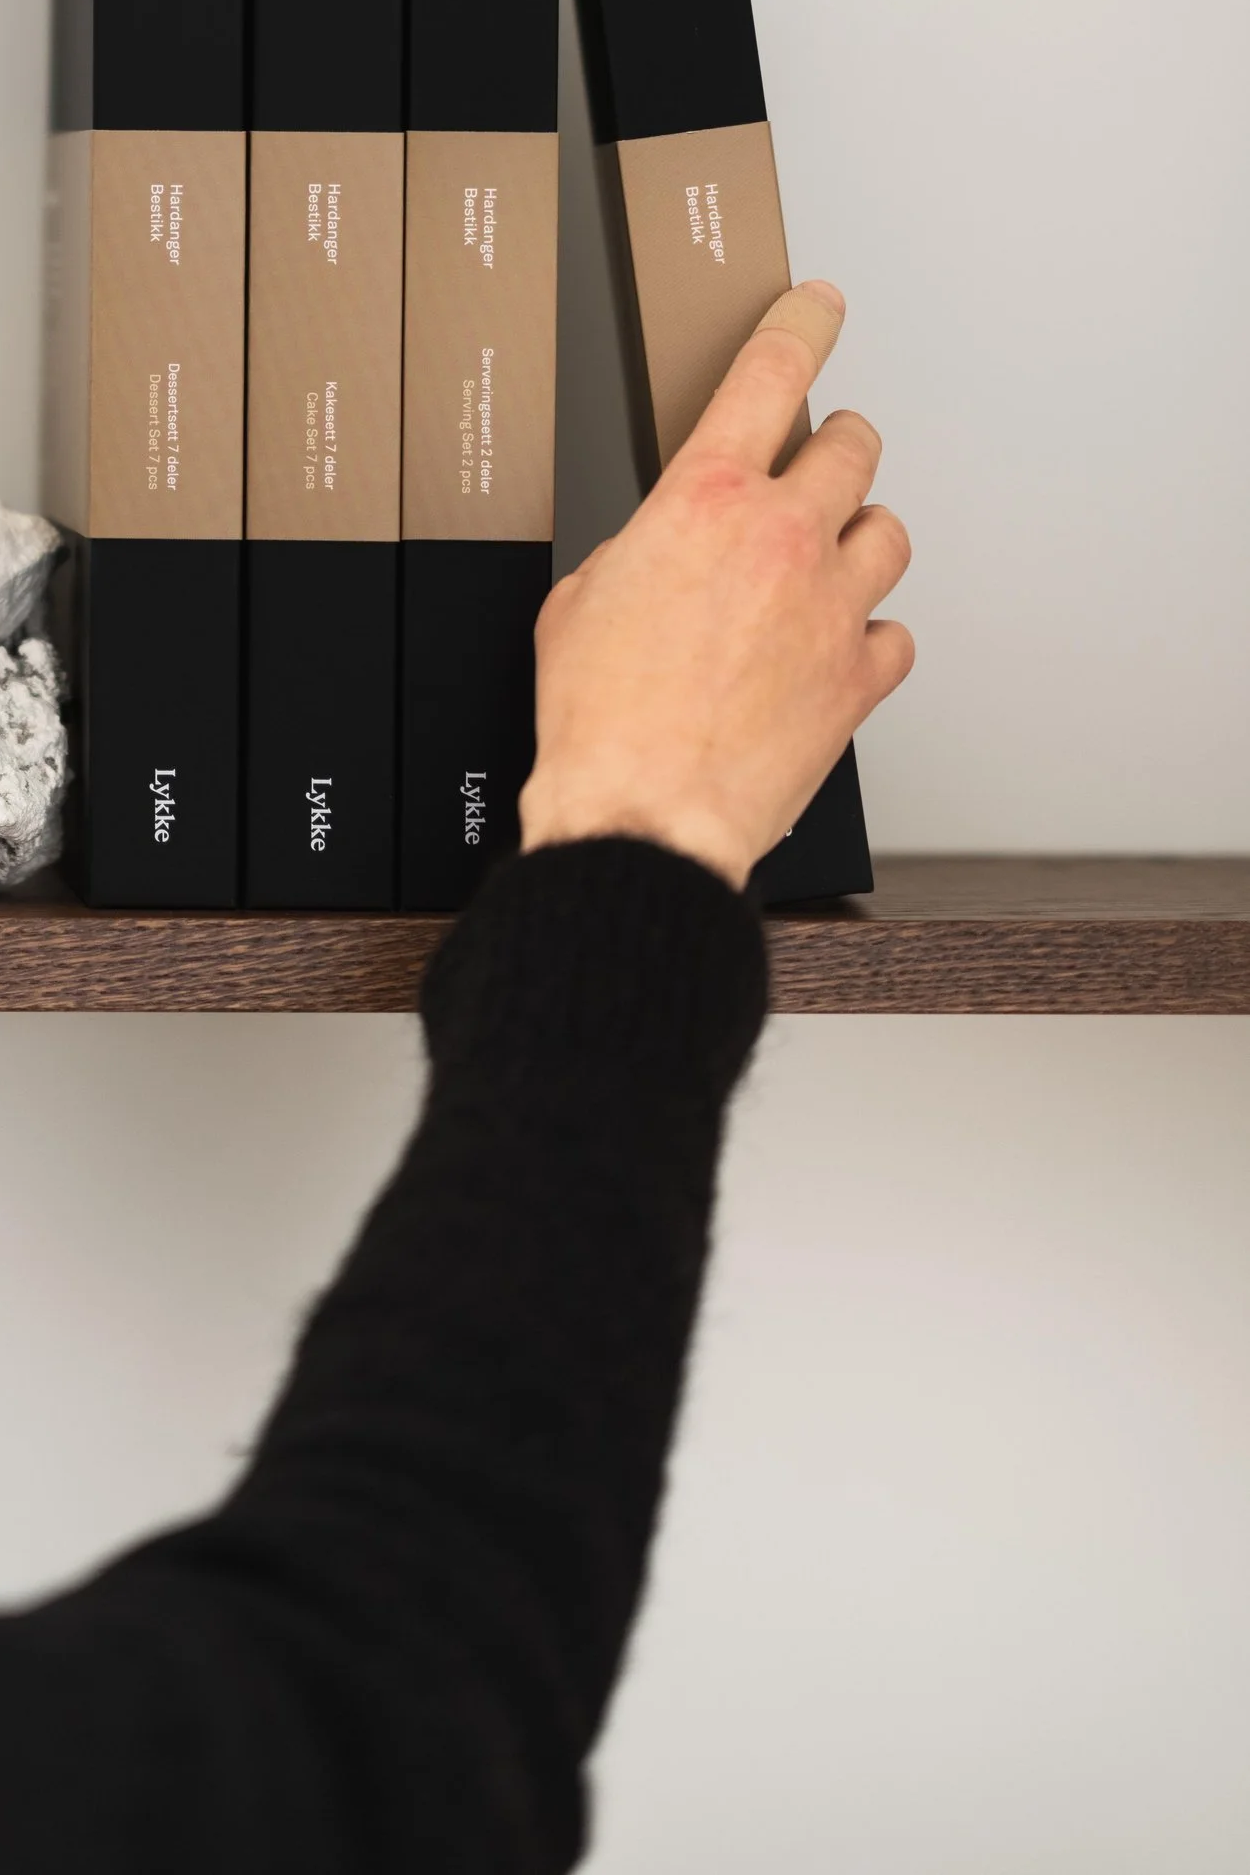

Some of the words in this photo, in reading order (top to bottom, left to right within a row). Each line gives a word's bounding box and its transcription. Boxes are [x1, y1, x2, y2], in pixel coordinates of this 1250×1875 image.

[149, 184, 166, 242] Bestikk
[165, 184, 184, 266] Hardanger
[307, 184, 324, 241] Bestikk
[322, 184, 342, 265] Hardanger
[462, 188, 479, 245] Bestikk
[479, 188, 498, 269] Hardanger
[685, 186, 706, 244] Bestikk
[704, 184, 726, 264] Hardanger
[148, 374, 162, 425] Dessert
[165, 363, 181, 441] Dessertsett
[305, 391, 319, 426] Cake
[324, 381, 339, 441] Kakesett
[458, 379, 475, 430] Serving
[477, 348, 495, 445] Serveringssett
[148, 428, 162, 452] Set
[148, 454, 161, 463] 7
[167, 444, 180, 453] 7
[305, 428, 319, 451] Set
[305, 454, 318, 462] 7
[324, 443, 338, 452] 7
[461, 432, 475, 455] Set
[480, 448, 494, 457] 2
[145, 466, 158, 490] pcs
[166, 456, 180, 491] deler
[302, 465, 315, 490] pcs
[323, 456, 338, 490] deler
[458, 470, 471, 494] pcs
[461, 458, 474, 467] 2
[479, 460, 493, 495] deler
[148, 768, 178, 844] Lykke
[304, 777, 333, 852] Lykke
[459, 771, 487, 846] Lykke
